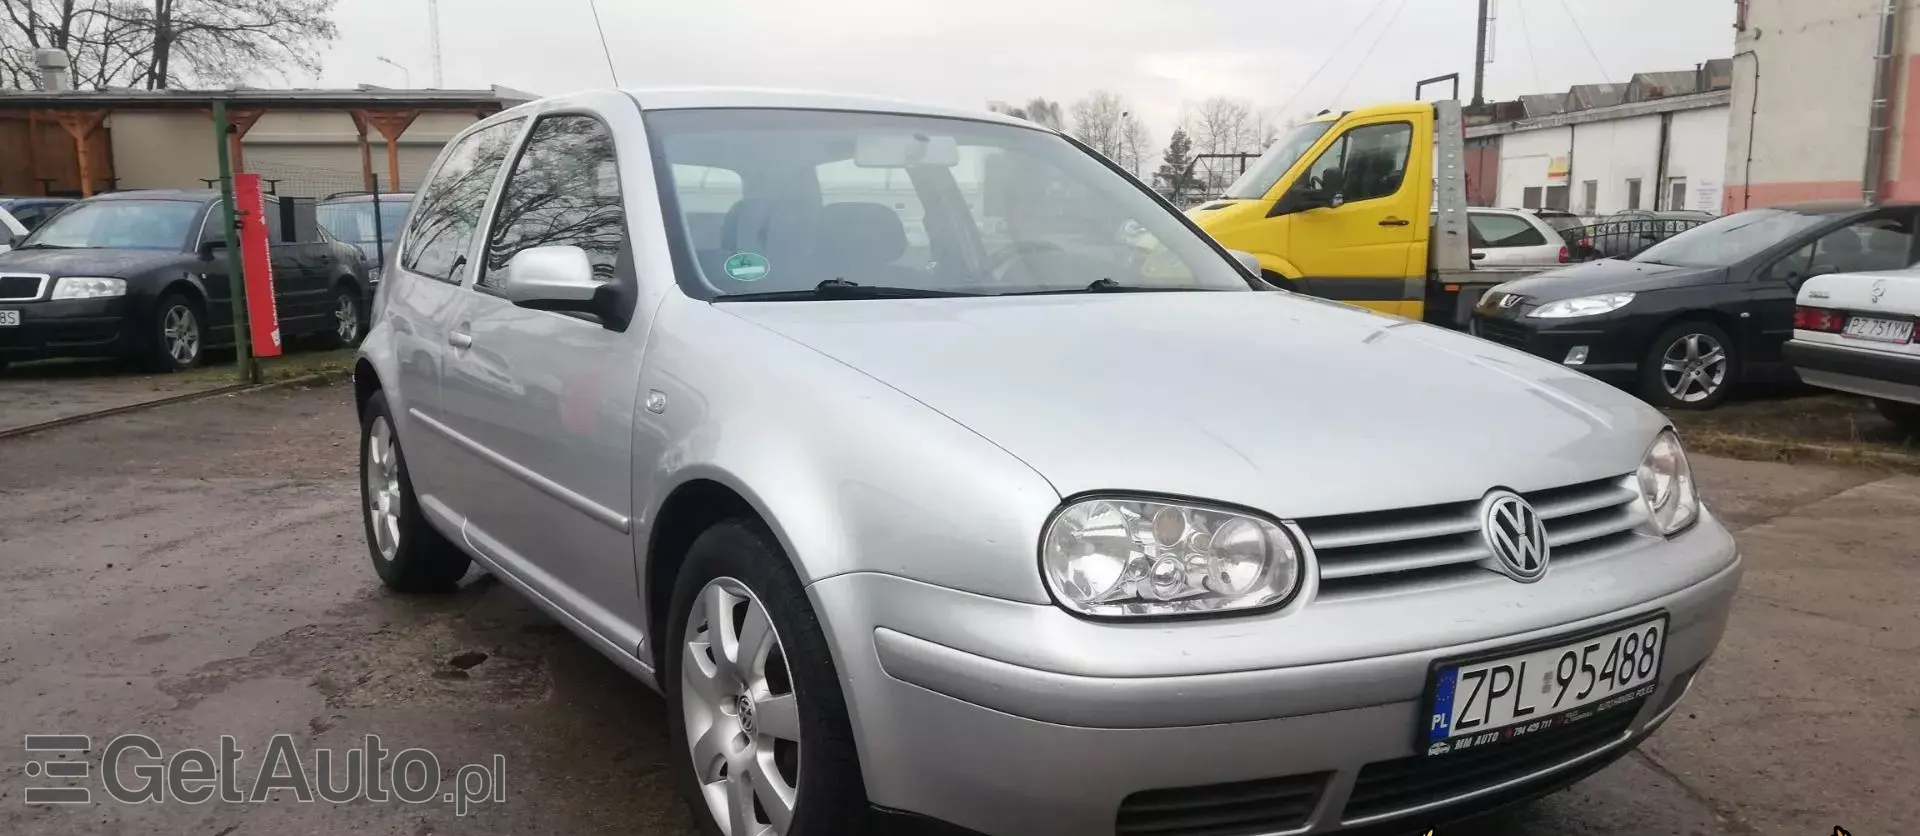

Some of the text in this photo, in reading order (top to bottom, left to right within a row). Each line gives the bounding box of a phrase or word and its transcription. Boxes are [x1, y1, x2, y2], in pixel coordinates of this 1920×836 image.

[0, 311, 16, 324] 8S
[1850, 318, 1868, 334] PZ
[1454, 627, 1658, 731] ZPL 95488
[1431, 713, 1448, 731] PL
[1454, 737, 1473, 750] MM
[1475, 732, 1499, 746] AUTO
